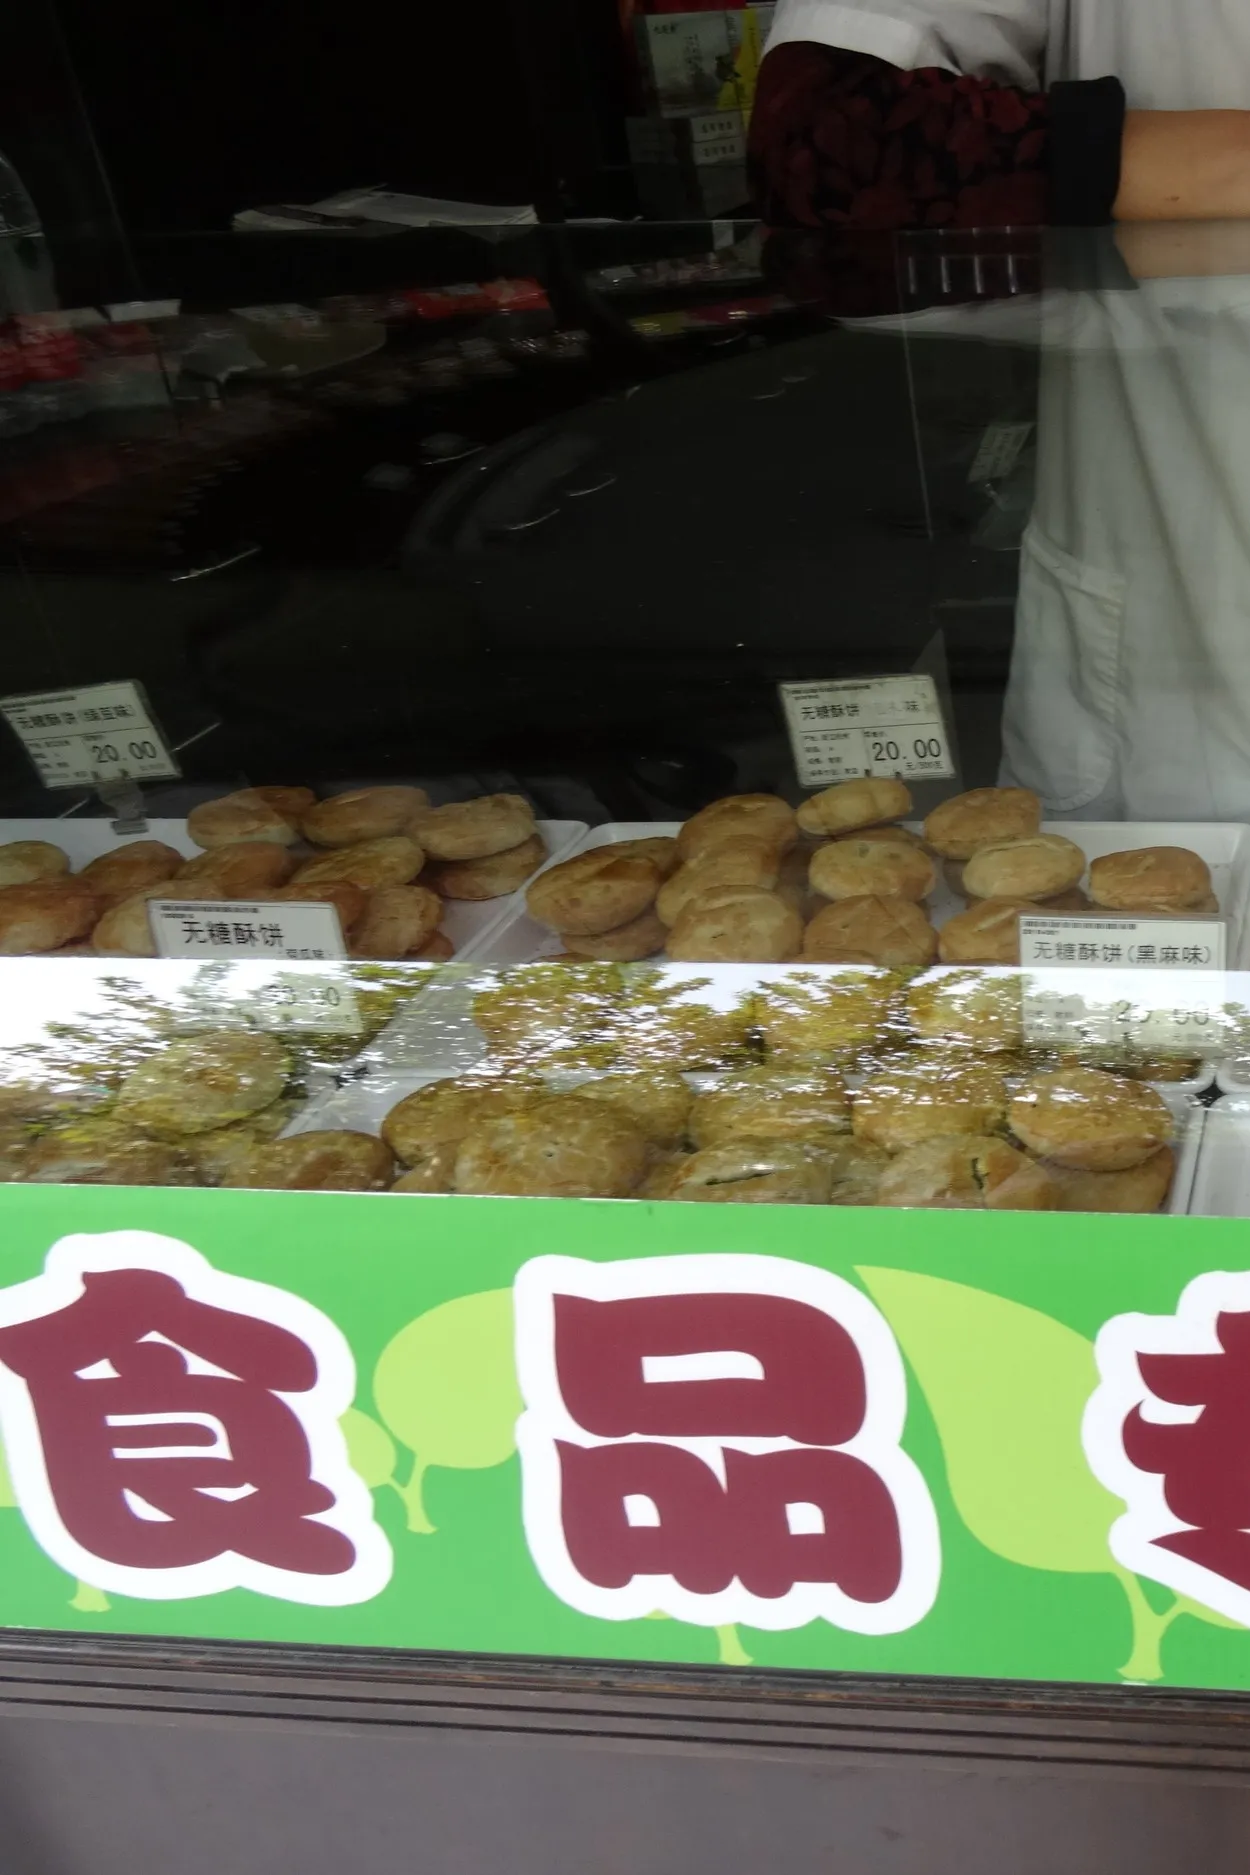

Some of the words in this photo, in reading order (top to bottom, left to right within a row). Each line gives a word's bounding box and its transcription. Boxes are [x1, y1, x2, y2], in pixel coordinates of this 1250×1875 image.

[91, 740, 158, 764] 20.00
[871, 738, 942, 762] 20.00
[181, 920, 285, 948] 无糖酥饼
[1033, 941, 1212, 965] 无糖酥饼(黑麻味)
